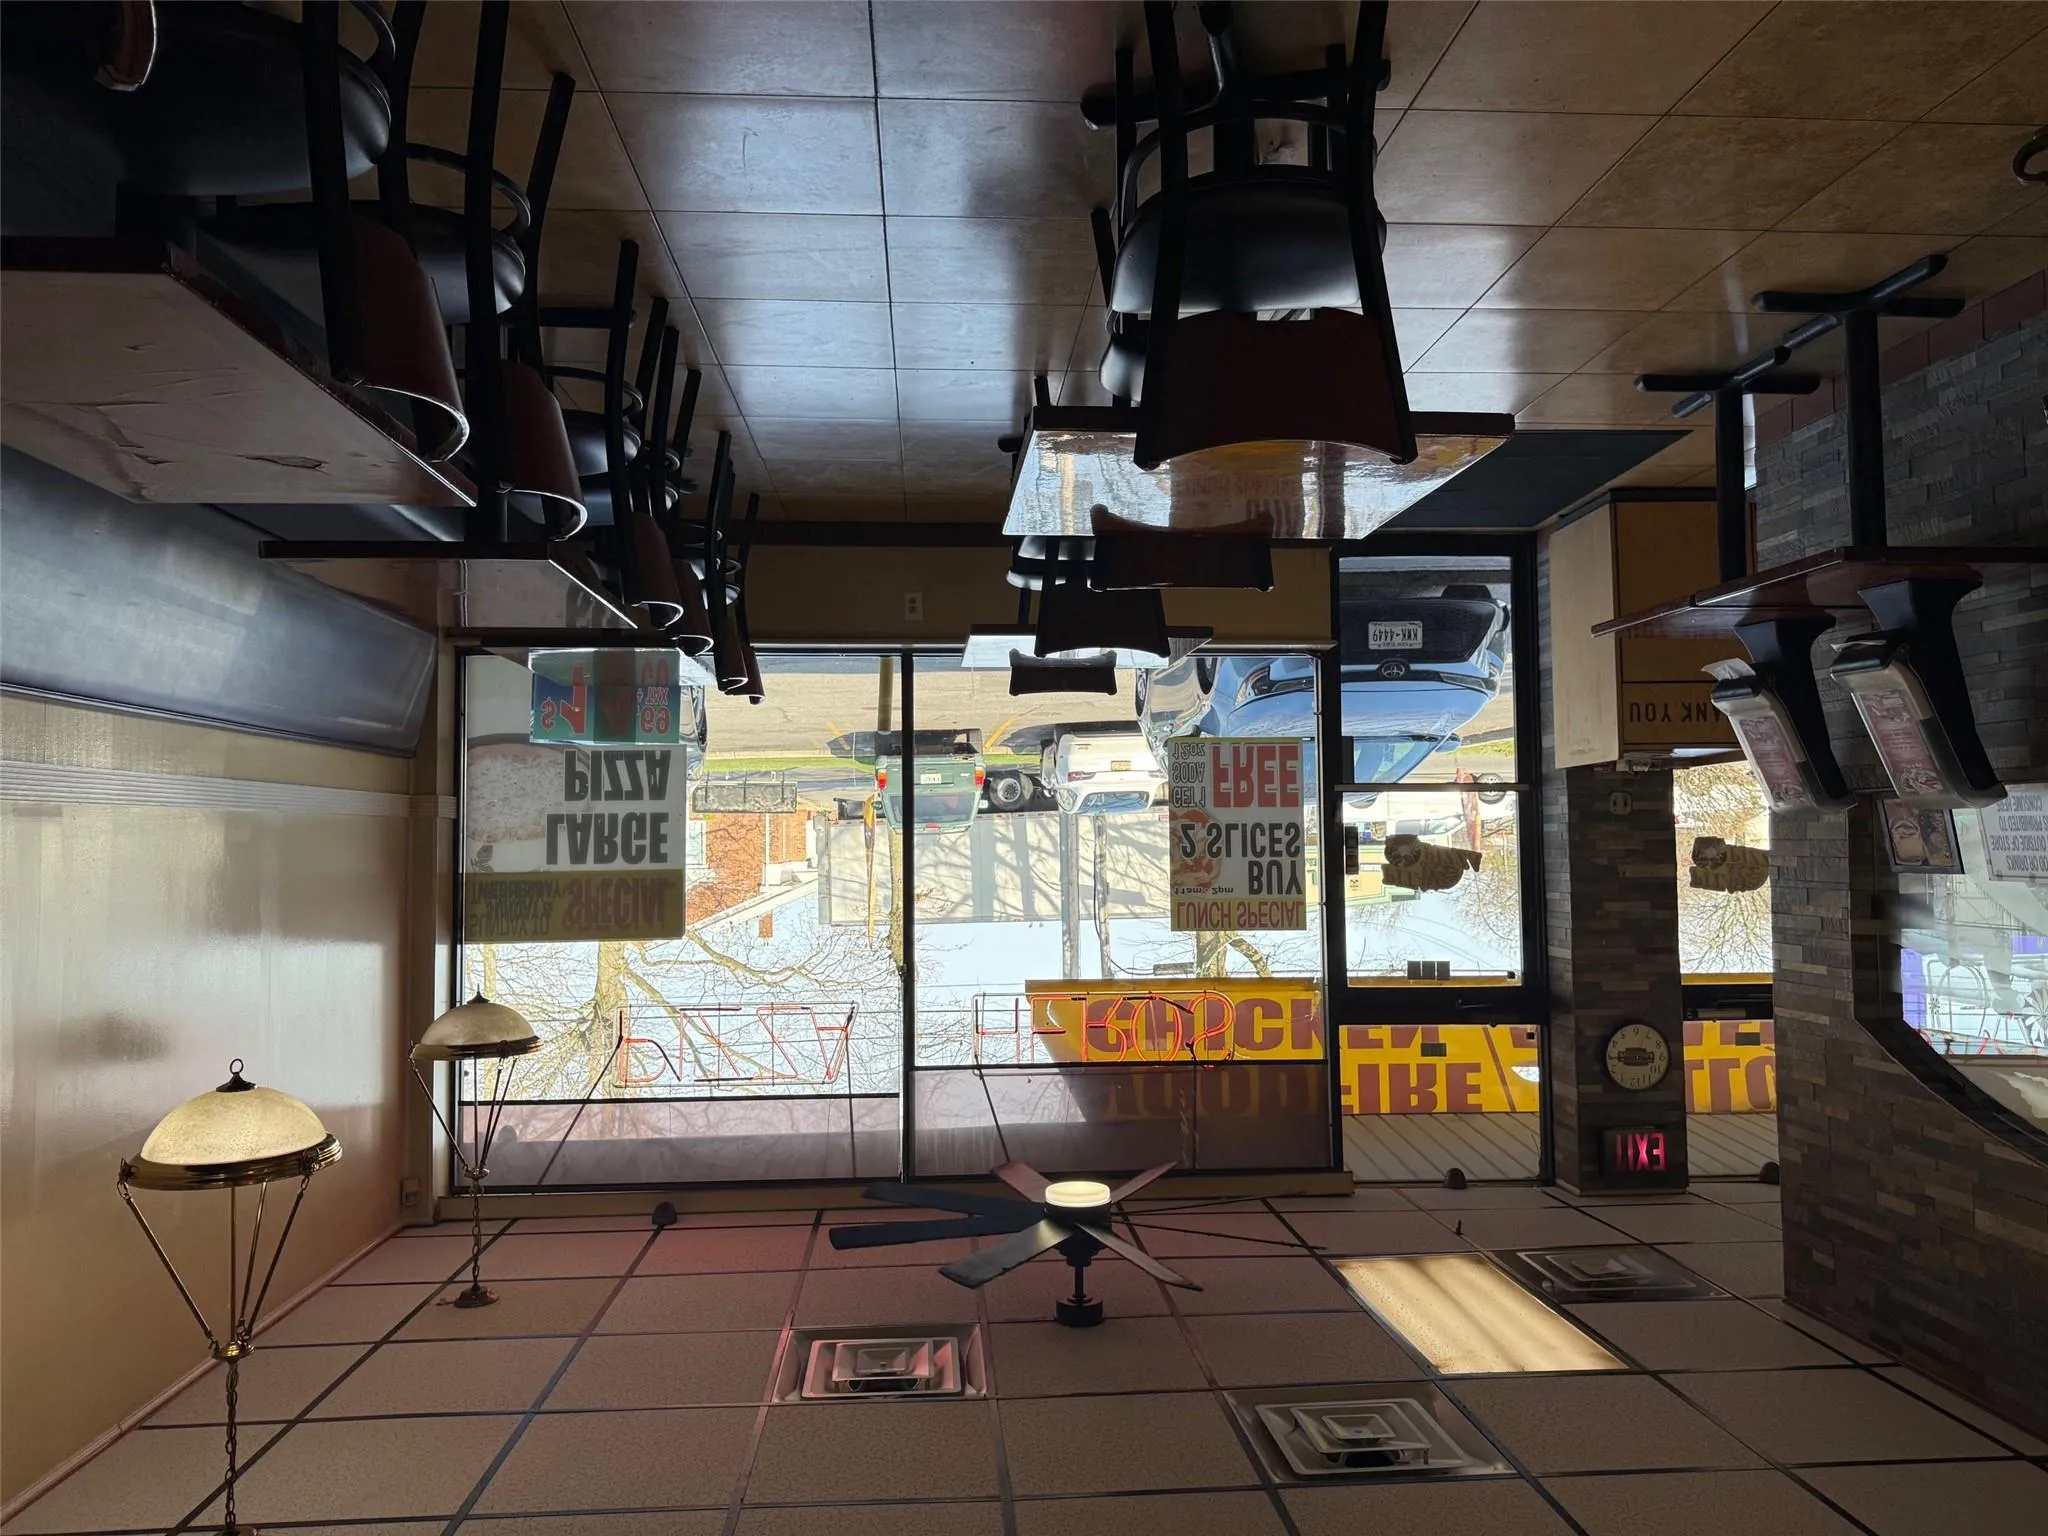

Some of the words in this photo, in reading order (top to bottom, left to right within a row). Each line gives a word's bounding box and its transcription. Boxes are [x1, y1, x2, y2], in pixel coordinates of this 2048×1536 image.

[1629, 702, 1672, 723] YOU
[1681, 702, 1722, 723] ANK
[1998, 816, 2007, 831] TO
[1990, 836, 2012, 850] STORE
[2020, 836, 2047, 850] OUTSIDE
[1616, 1132, 1667, 1171] EXIT
